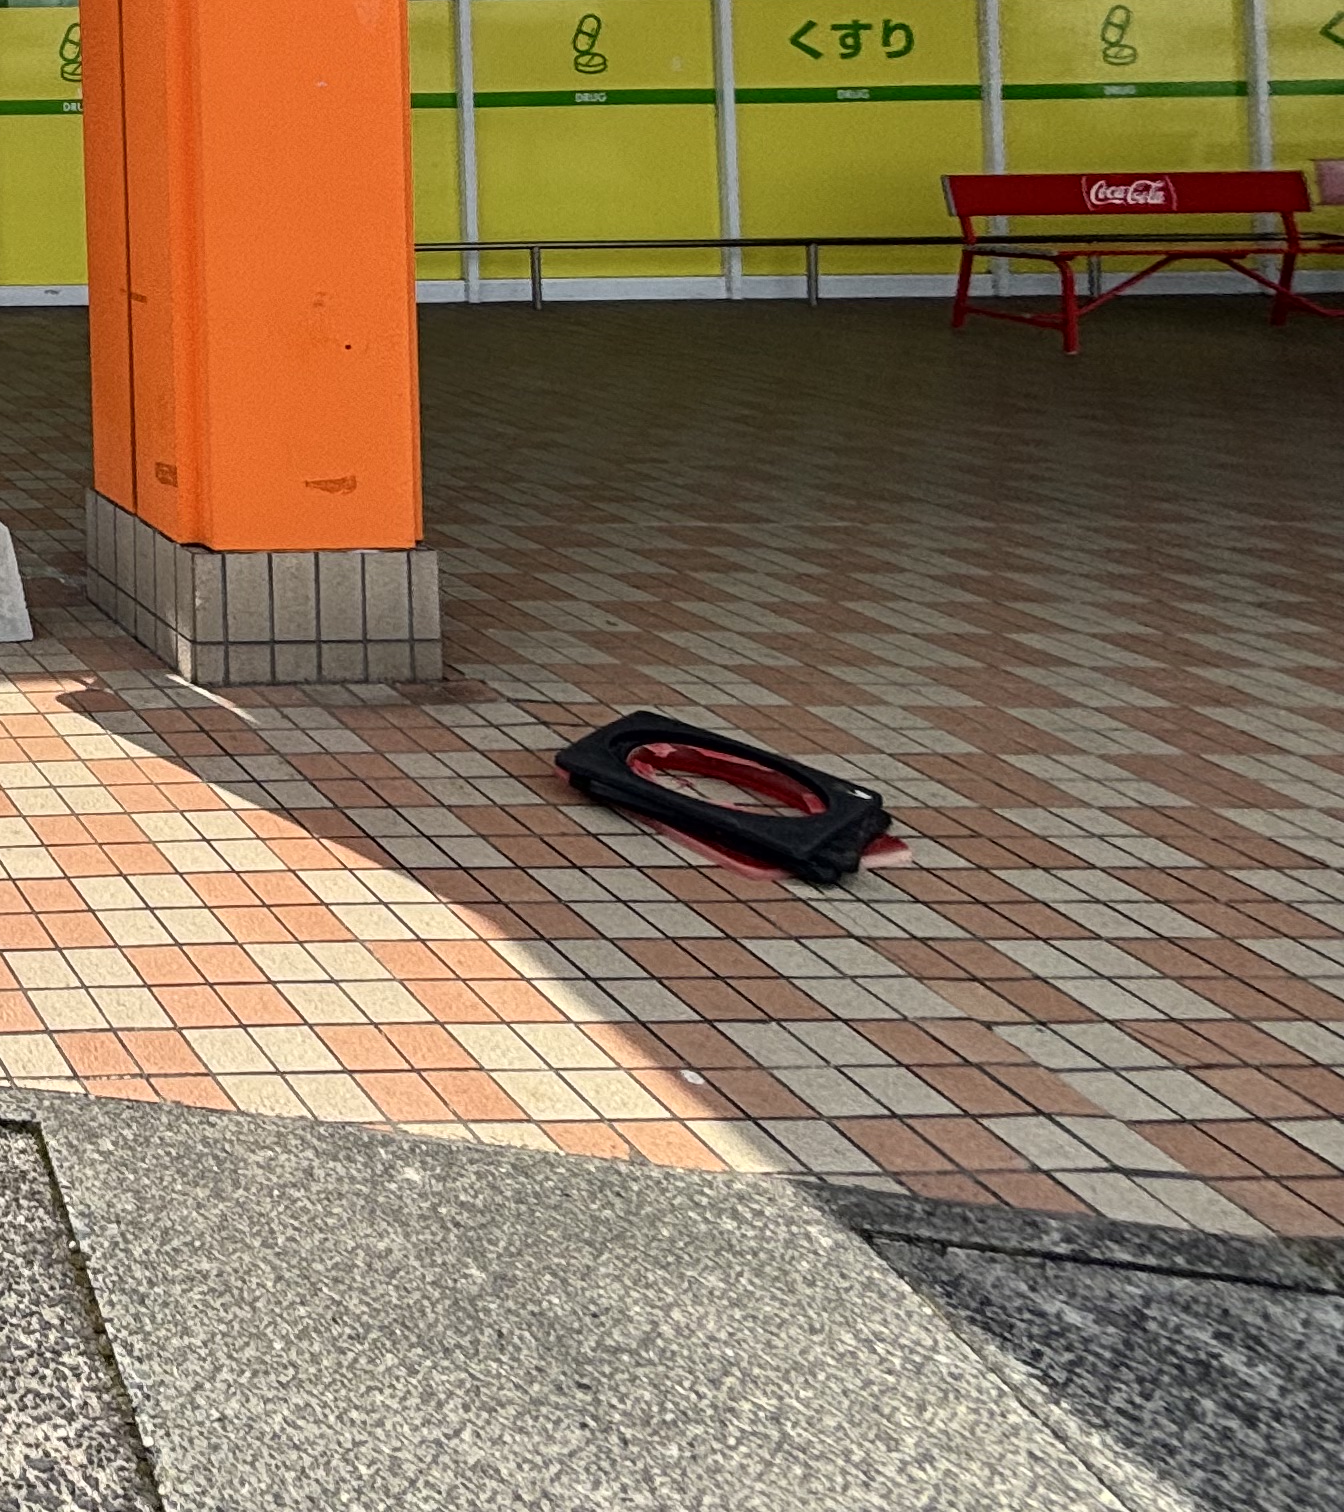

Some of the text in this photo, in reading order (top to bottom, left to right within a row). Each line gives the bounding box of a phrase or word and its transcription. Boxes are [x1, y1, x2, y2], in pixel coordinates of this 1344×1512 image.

[789, 18, 915, 60] くすり
[574, 92, 608, 103] DRUG
